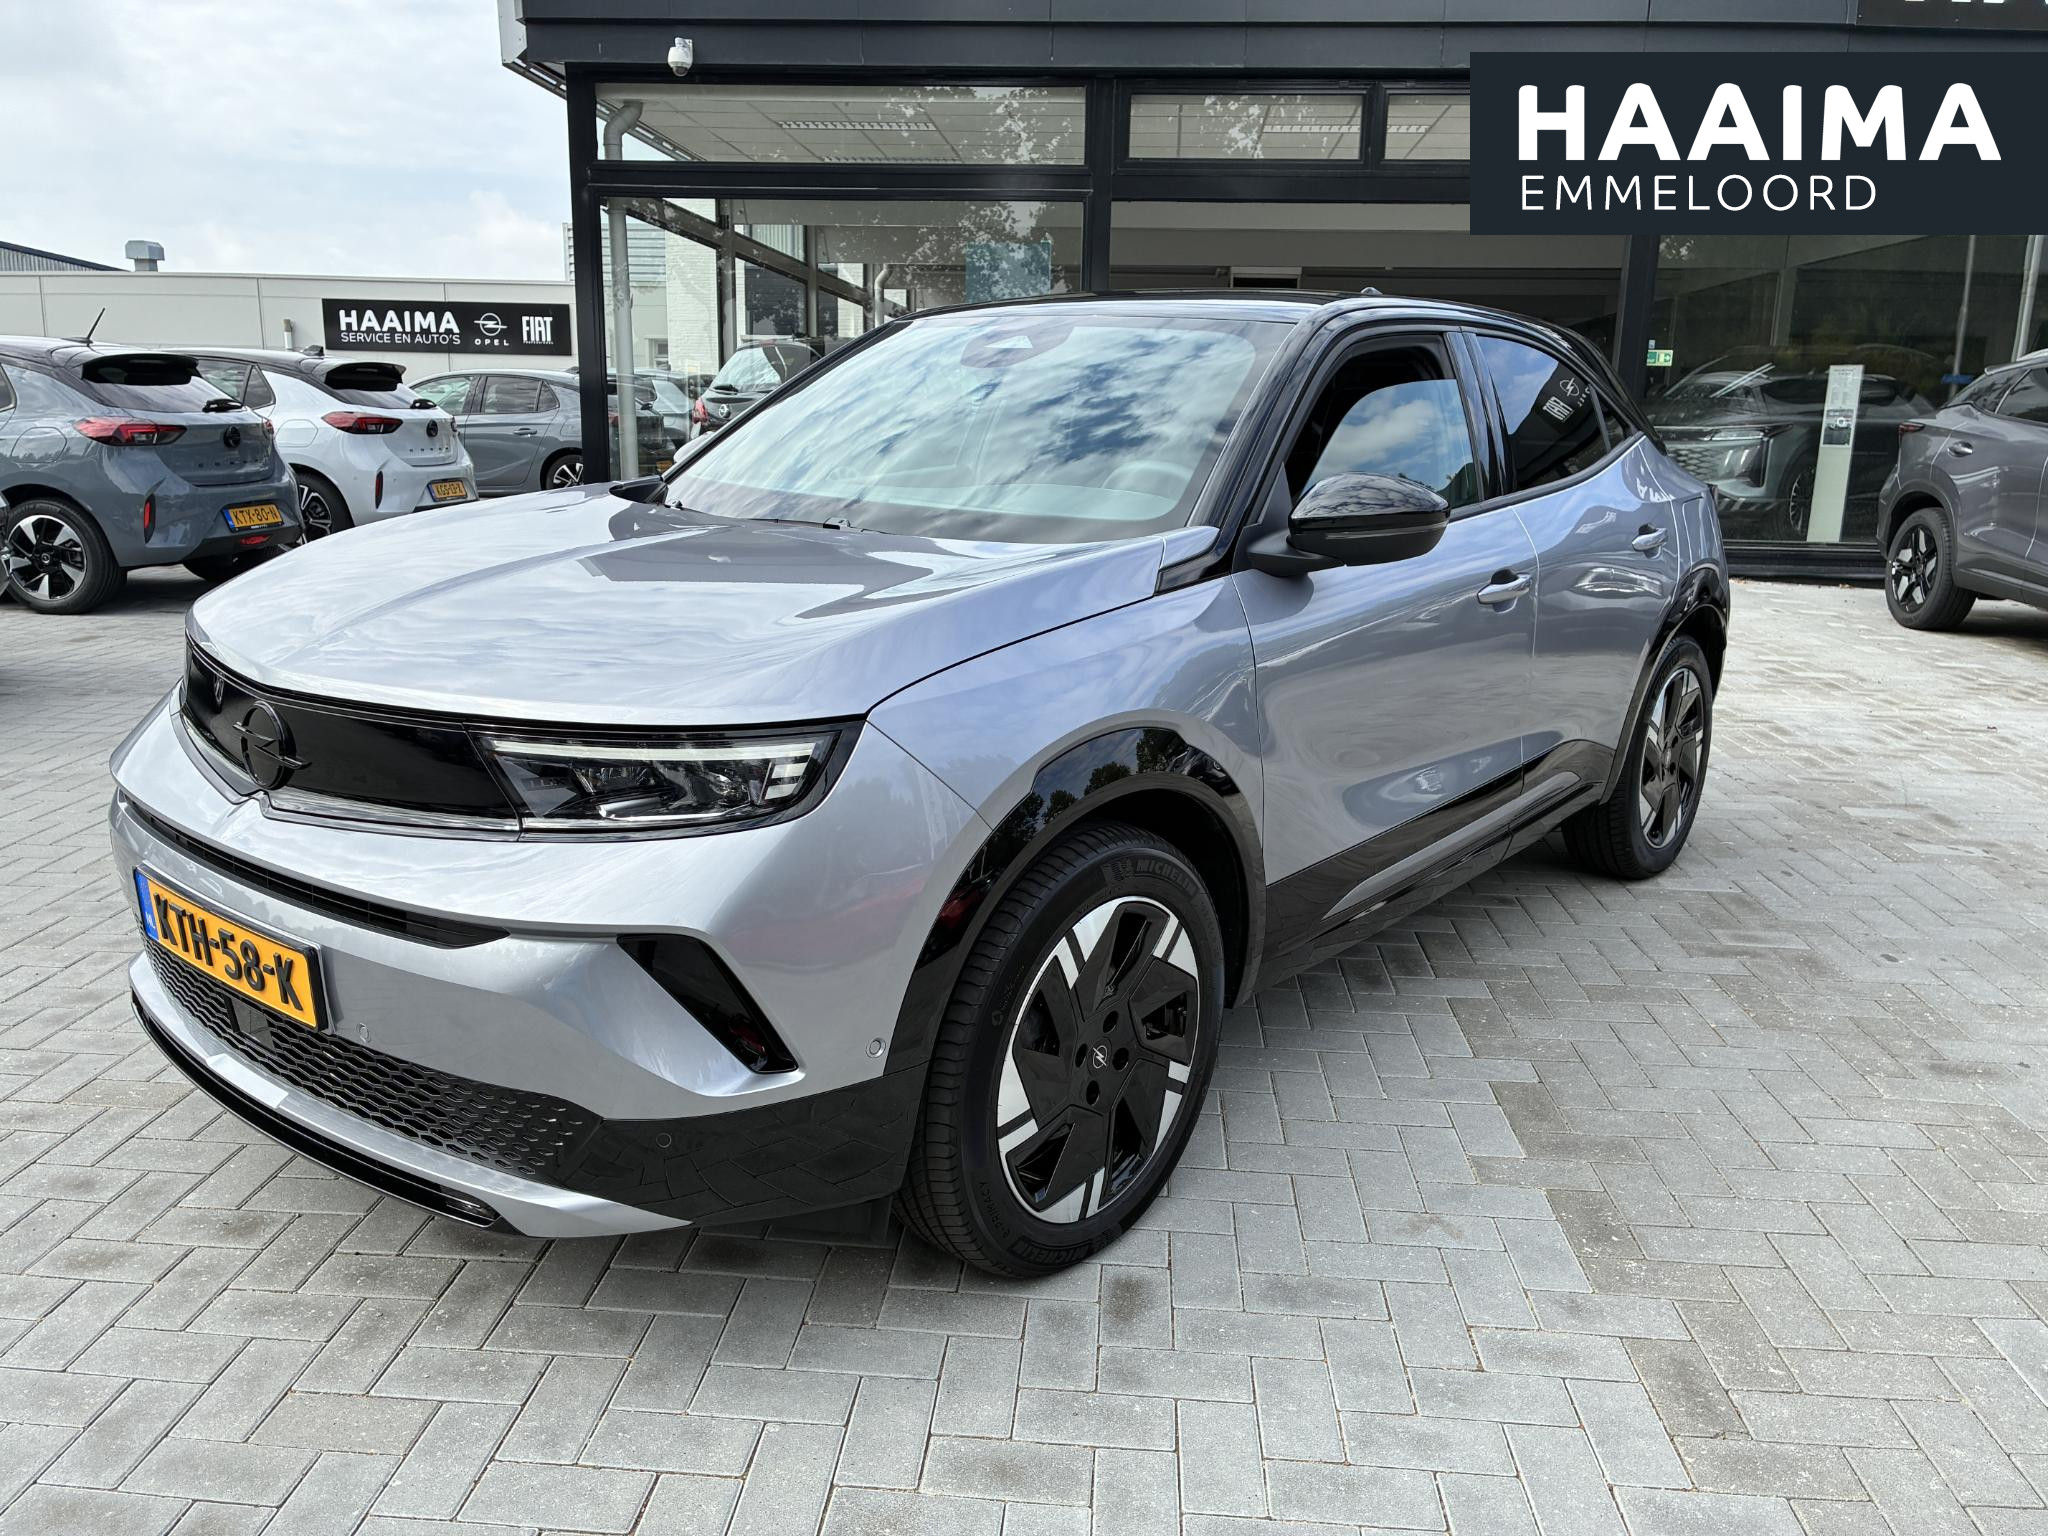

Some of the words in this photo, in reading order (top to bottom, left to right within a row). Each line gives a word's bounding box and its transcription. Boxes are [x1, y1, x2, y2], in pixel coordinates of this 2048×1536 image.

[339, 309, 460, 333] HAAIMA
[522, 316, 553, 342] FIAT
[341, 332, 391, 343] SERVICE
[395, 333, 411, 343] EN
[414, 334, 460, 345] AUTO'S
[474, 338, 509, 346] OPEL
[233, 508, 279, 526] KTX-80-N
[145, 910, 156, 930] NL
[153, 892, 304, 1012] KTH-58-K
